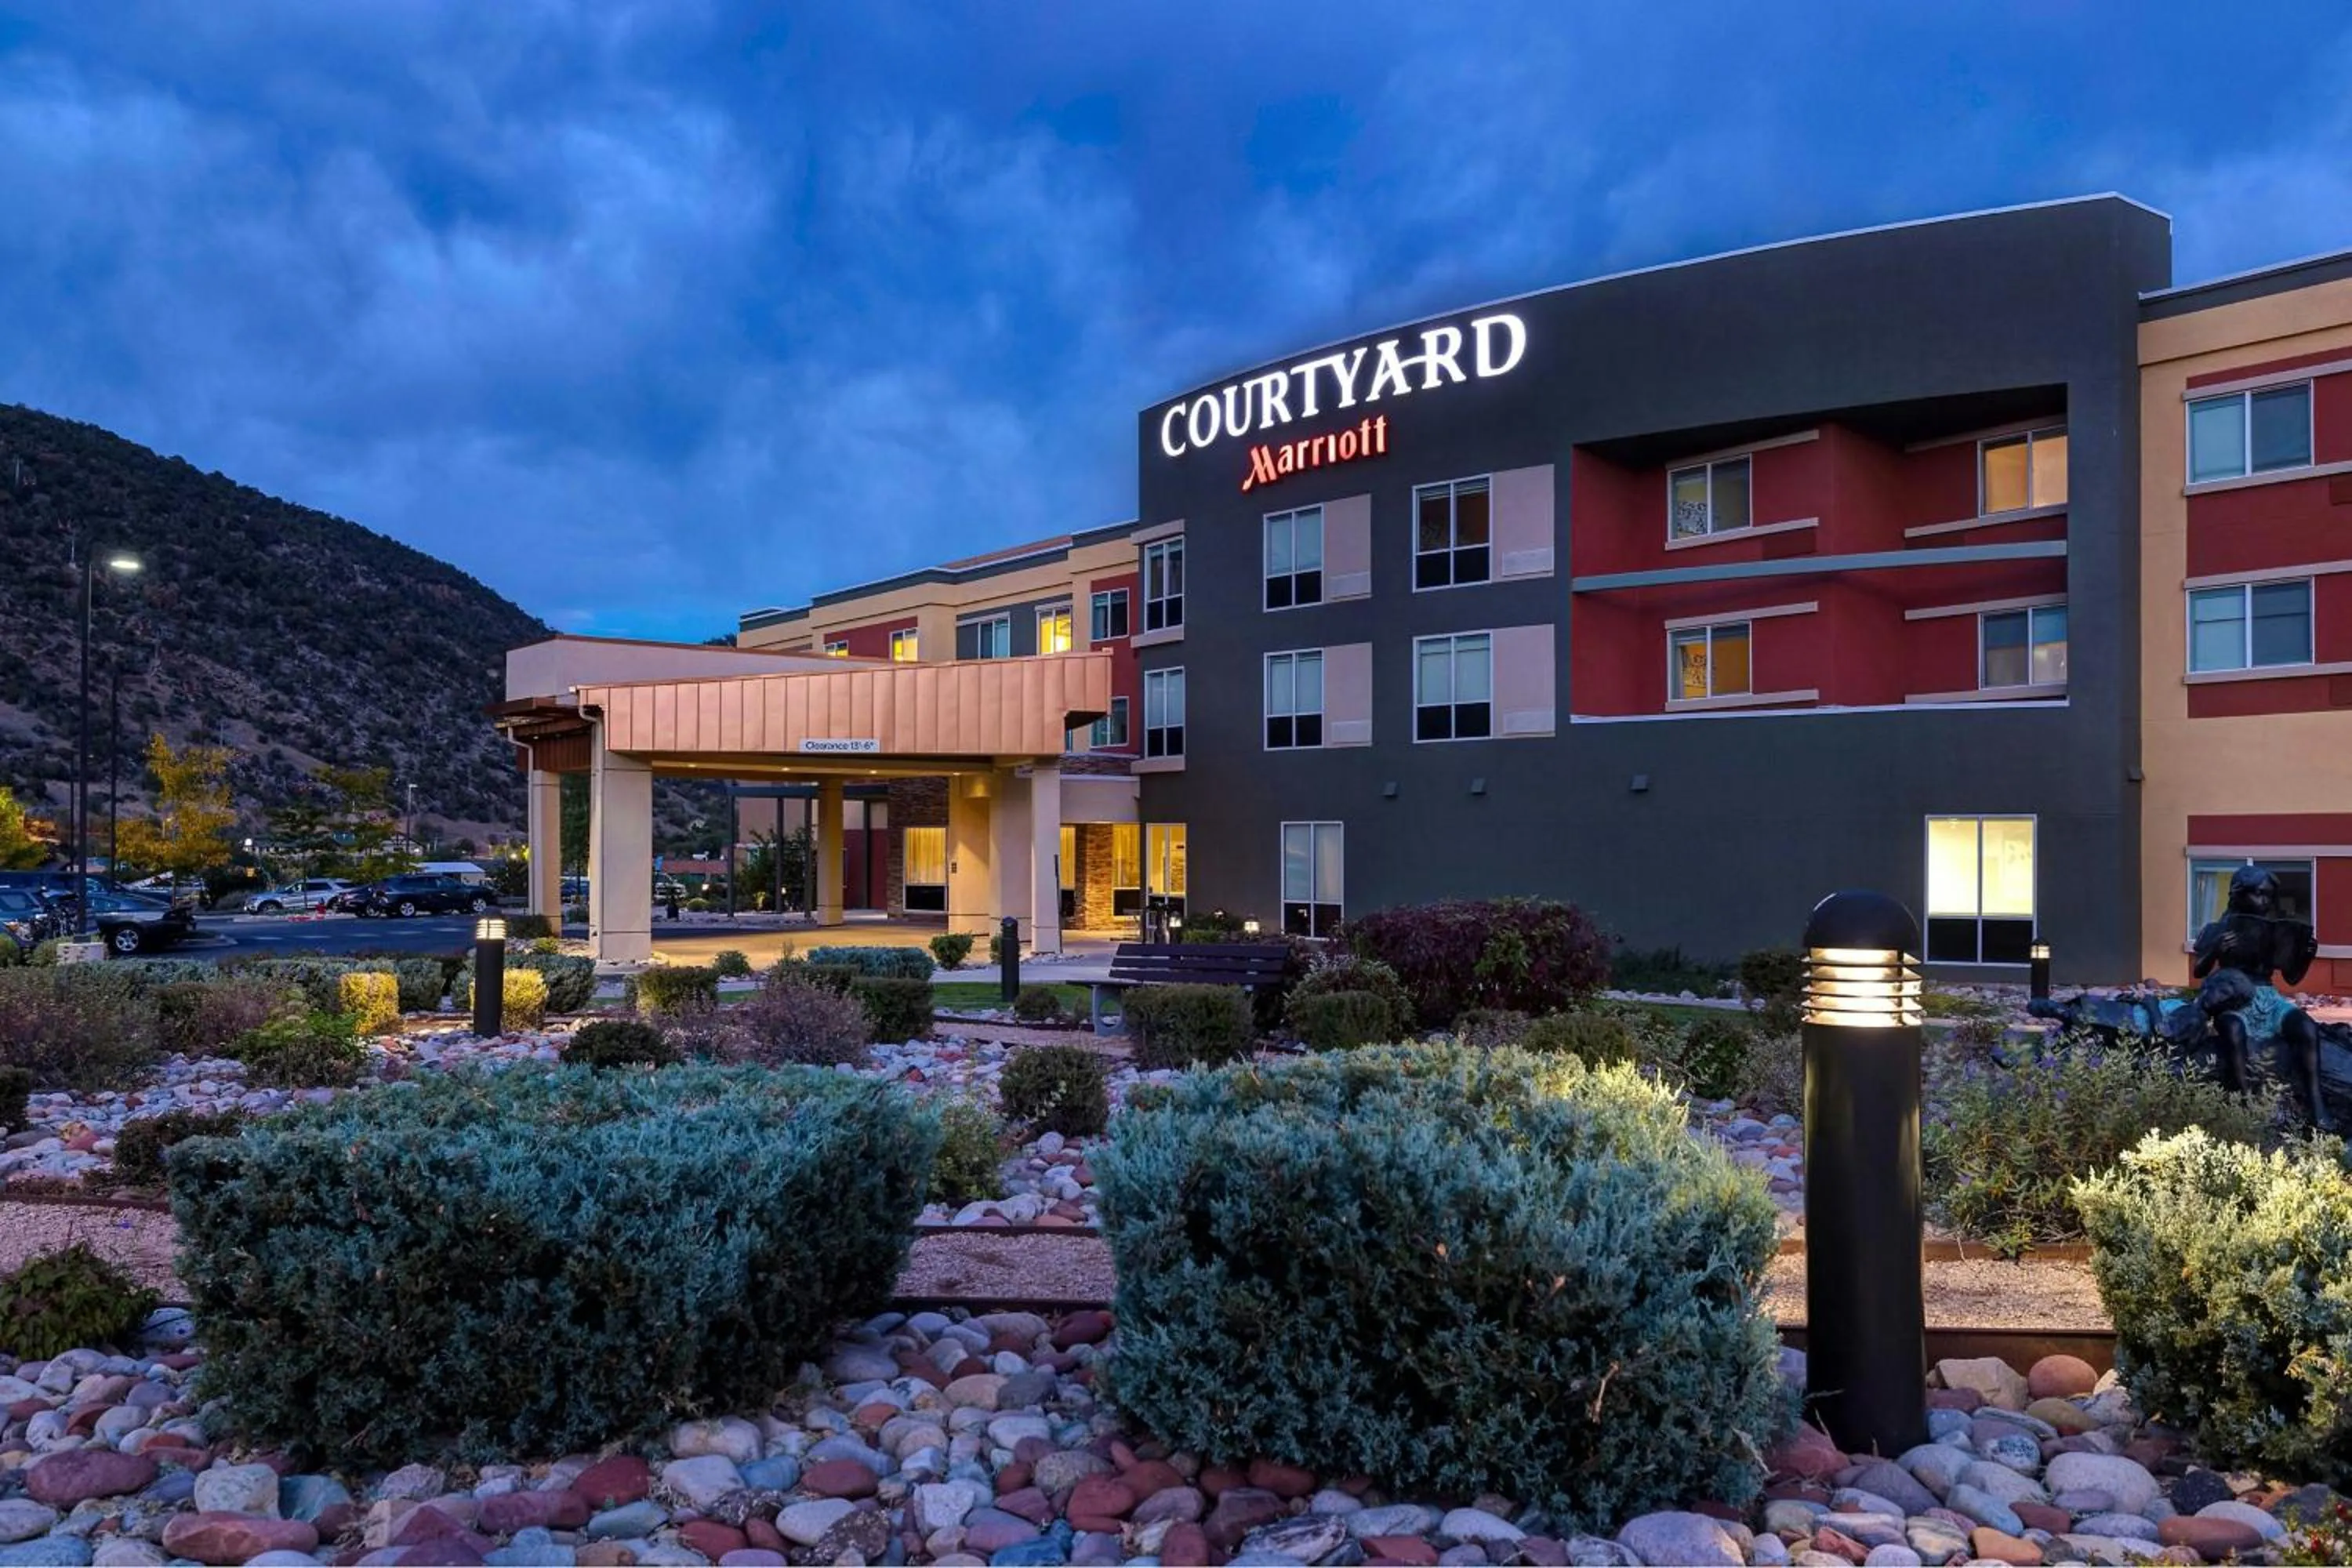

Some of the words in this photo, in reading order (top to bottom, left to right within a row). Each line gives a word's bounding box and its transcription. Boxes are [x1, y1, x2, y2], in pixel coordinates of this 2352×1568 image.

[1161, 314, 1526, 457] COURTYARD
[1241, 414, 1387, 492] Marriott
[805, 741, 848, 750] Clearance
